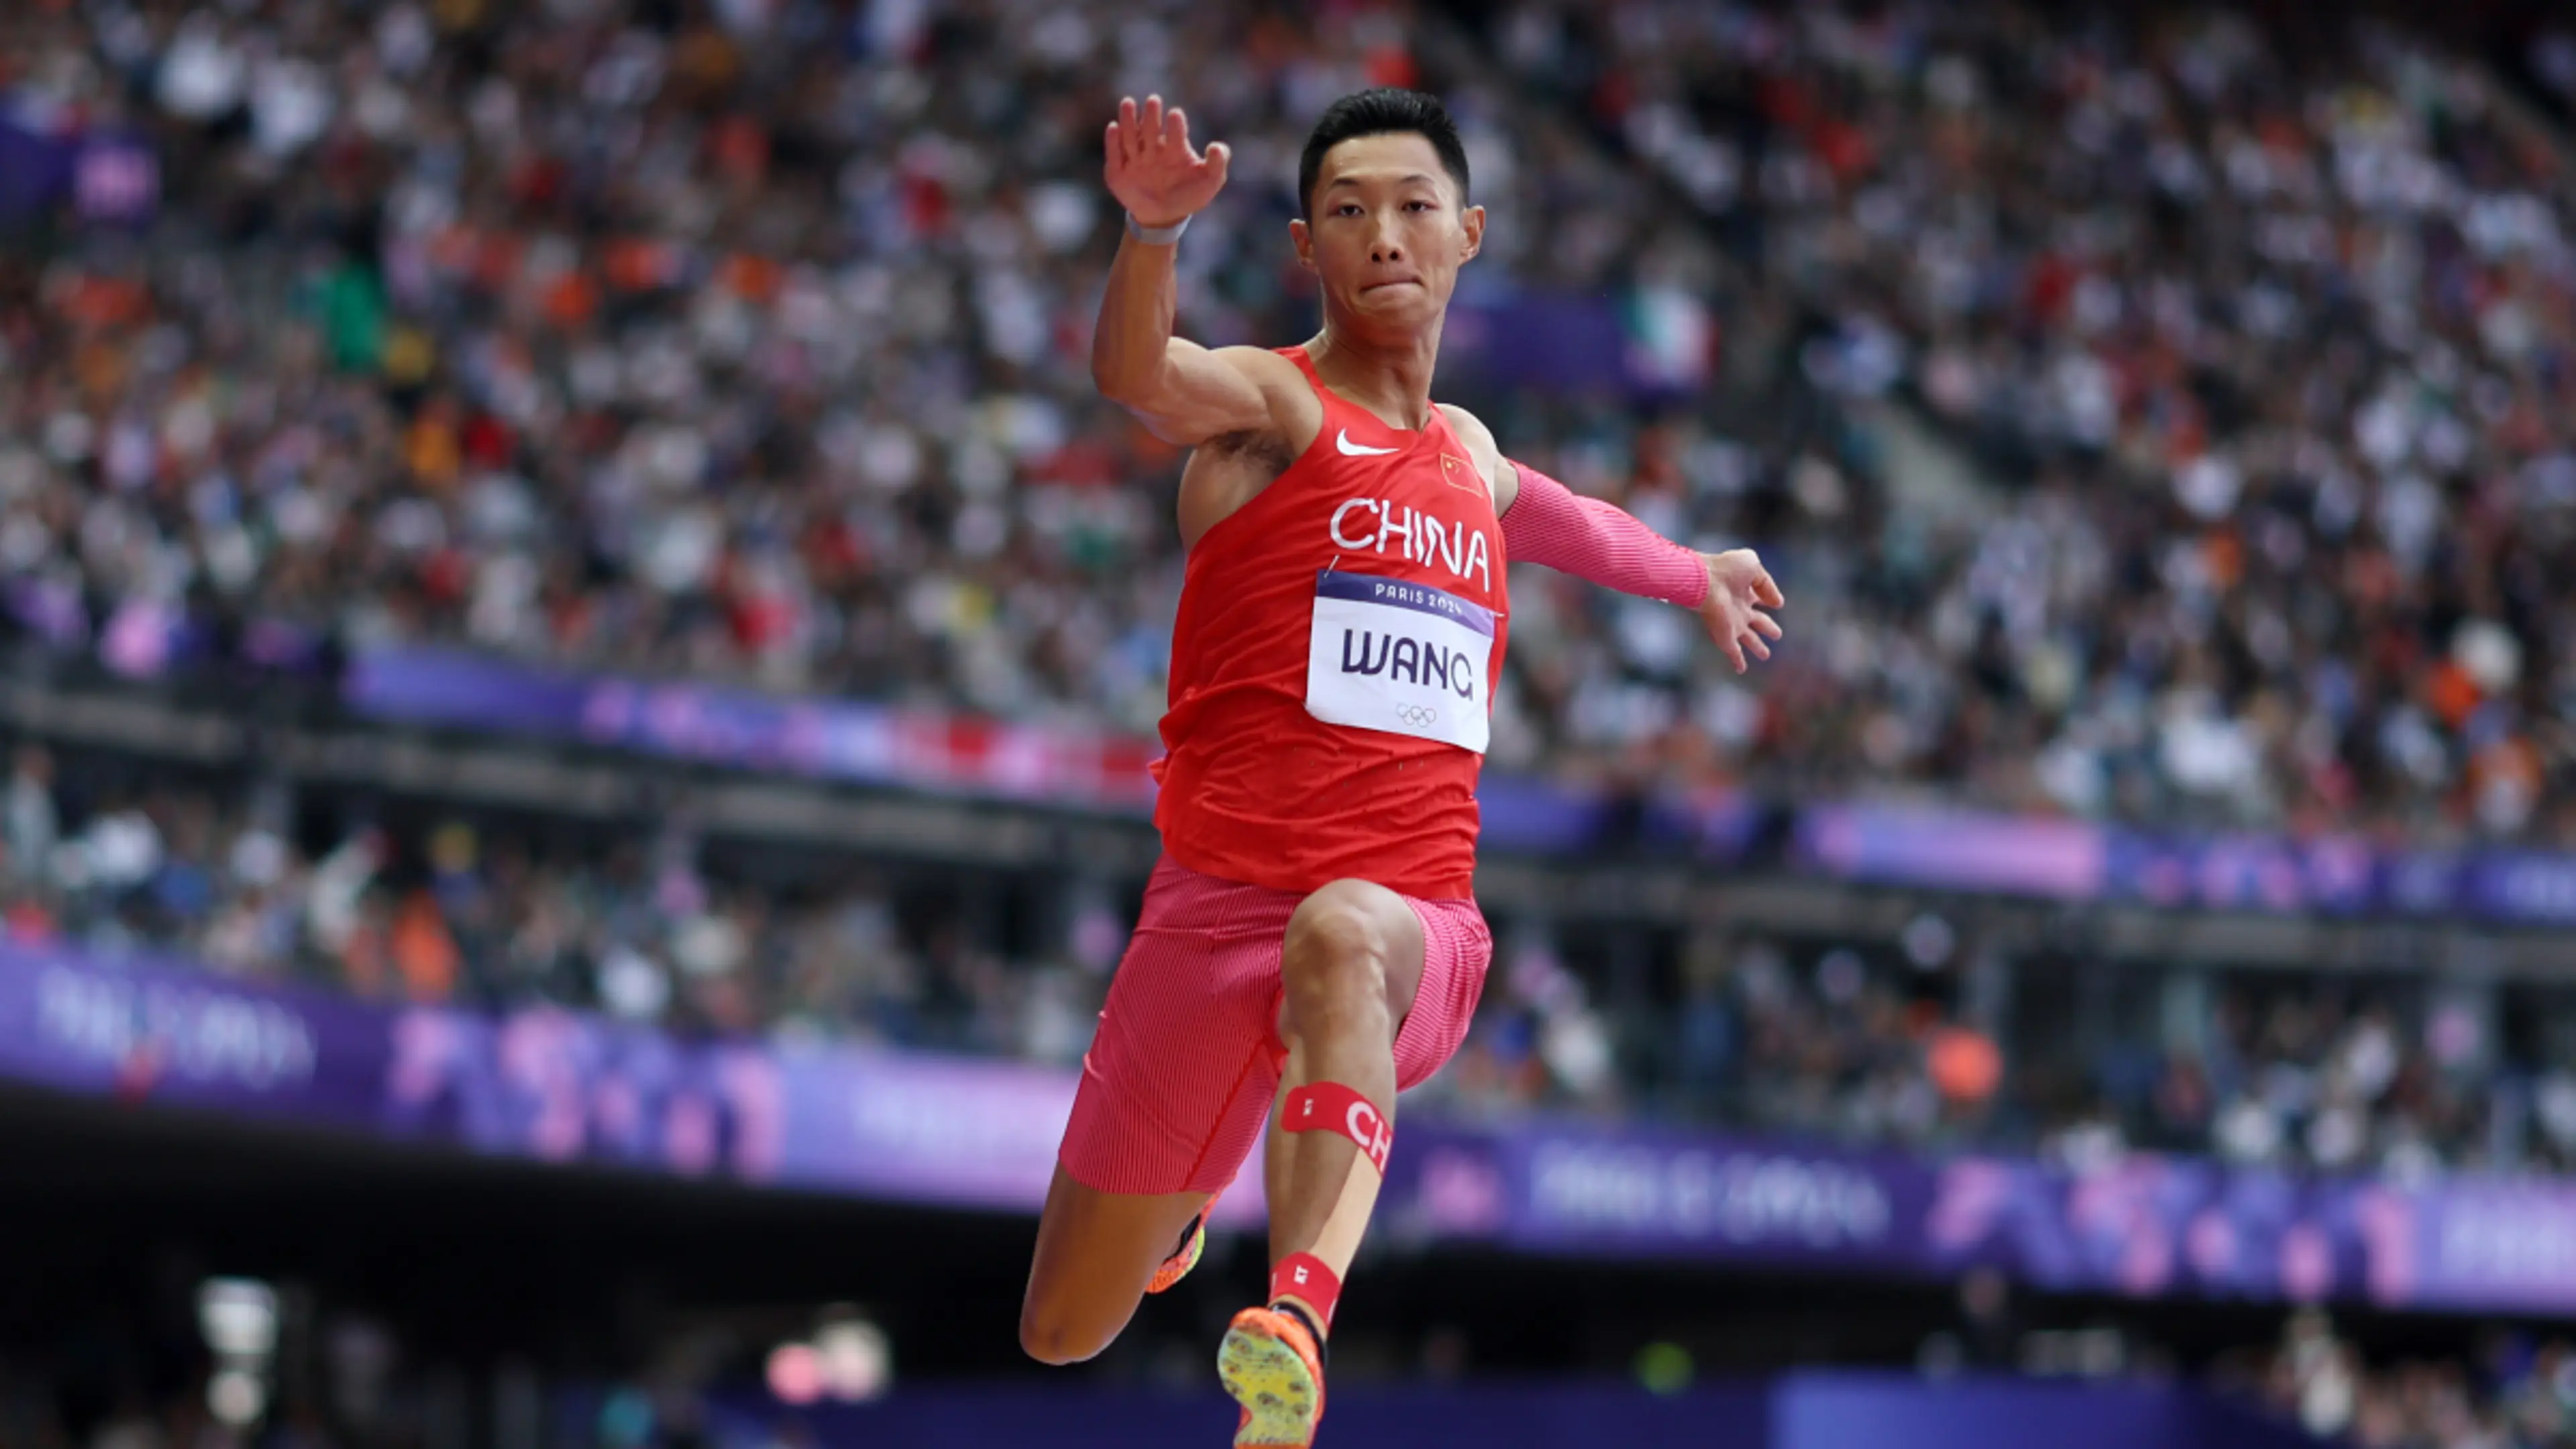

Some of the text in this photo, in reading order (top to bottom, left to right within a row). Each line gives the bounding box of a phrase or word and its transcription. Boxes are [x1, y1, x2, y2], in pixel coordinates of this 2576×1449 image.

[1330, 498, 1489, 592] CHINA
[1375, 583, 1462, 615] PARIS 2024
[1342, 629, 1473, 701] WANG
